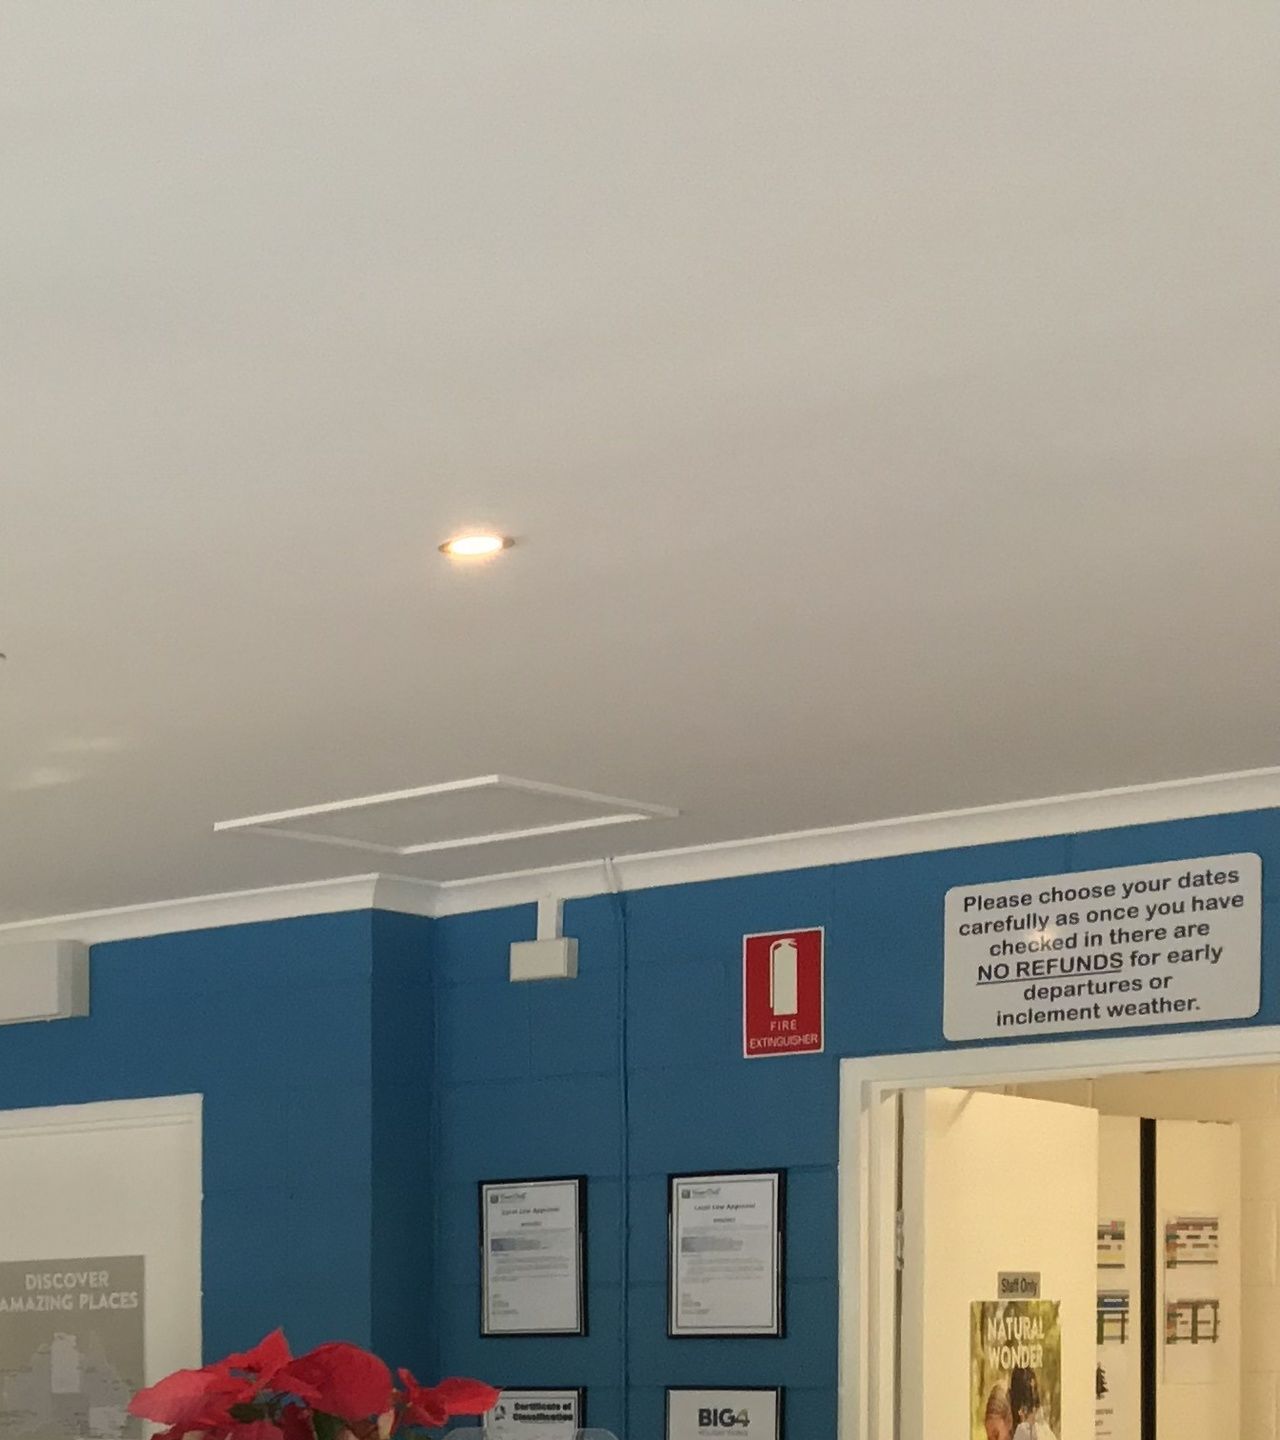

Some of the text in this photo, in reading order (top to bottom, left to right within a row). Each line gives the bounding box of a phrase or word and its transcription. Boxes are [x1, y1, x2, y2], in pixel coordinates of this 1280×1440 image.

[963, 868, 1240, 913] Please choose your dates
[958, 893, 1244, 937] carefully as once you have
[989, 922, 1210, 957] checked in there are
[977, 944, 1224, 982] NO REFUNDS for early
[1023, 974, 1173, 1003] departures or
[996, 996, 1202, 1027] inclement weather.
[770, 1019, 797, 1032] FIRE
[749, 1033, 819, 1050] EXTINGUISHER
[24, 1270, 110, 1291] DISCOVER
[1001, 1277, 1038, 1297] Staff Only
[78, 1291, 139, 1310] PLACES
[987, 1313, 1046, 1342] NATURAL
[989, 1344, 1044, 1370] WONDER
[512, 1413, 574, 1422] Classification
[514, 1402, 572, 1411] Certificate of
[698, 1408, 751, 1428] BIG4
